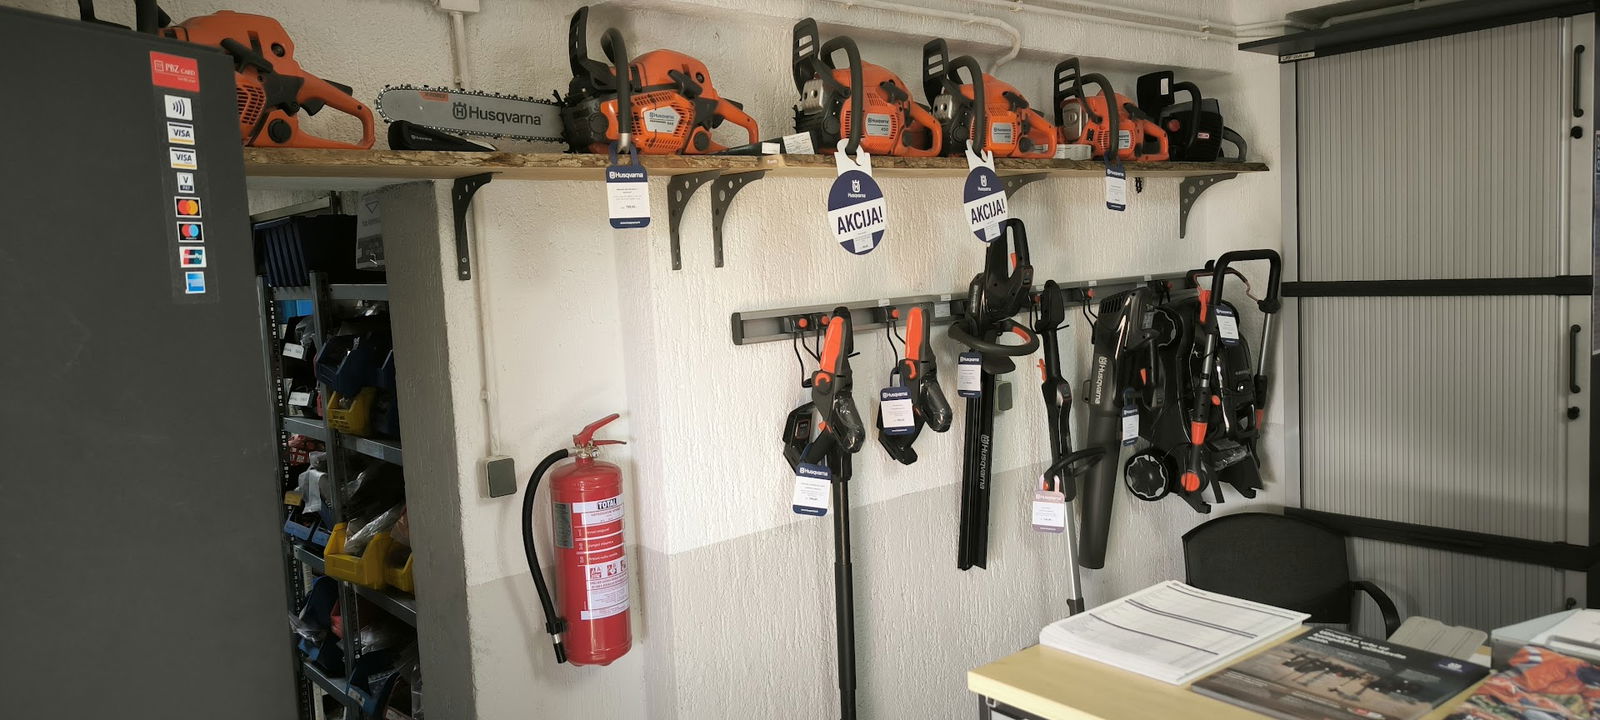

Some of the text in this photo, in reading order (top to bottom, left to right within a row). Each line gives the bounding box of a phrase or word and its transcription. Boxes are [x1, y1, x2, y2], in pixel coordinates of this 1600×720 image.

[165, 63, 180, 74] PBZ
[469, 106, 541, 125] Husqvarna
[173, 128, 190, 137] VISA
[175, 153, 192, 161] VISA
[182, 175, 189, 183] V
[615, 171, 644, 179] Husqvarna
[970, 198, 1006, 225] AKCIJA!
[837, 205, 884, 235] AKCIJA!
[1094, 364, 1106, 405] Husqvarna
[980, 443, 989, 490] Husqvarna
[804, 468, 828, 477] Husqvarna
[597, 498, 617, 509] TOTAL
